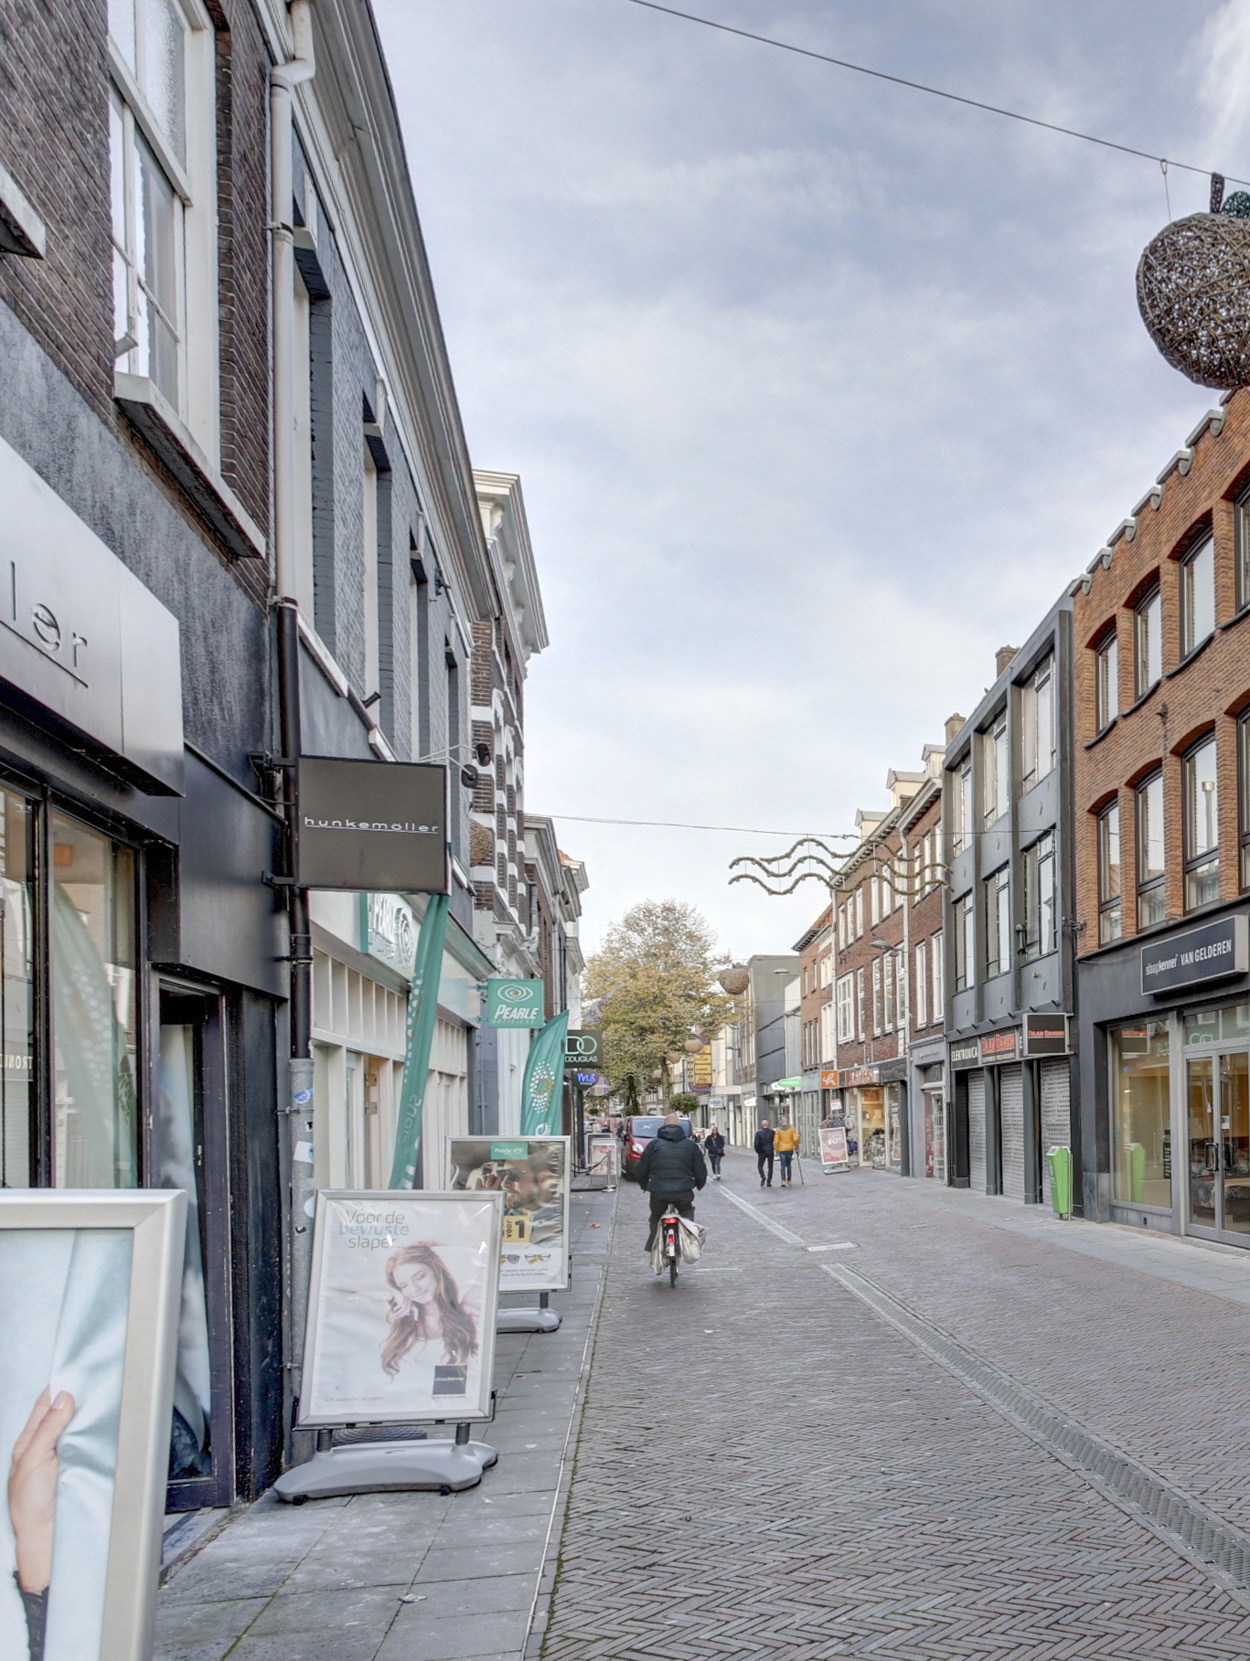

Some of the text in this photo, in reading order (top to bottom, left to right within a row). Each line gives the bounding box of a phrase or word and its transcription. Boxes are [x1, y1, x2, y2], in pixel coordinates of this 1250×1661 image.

[1180, 950, 1195, 966] VAN
[1195, 939, 1232, 962] GELDEREN
[494, 1004, 539, 1020] PEARLE
[346, 1209, 405, 1225] Voor de
[339, 1223, 410, 1237] bewuste
[514, 1219, 526, 1239] 1
